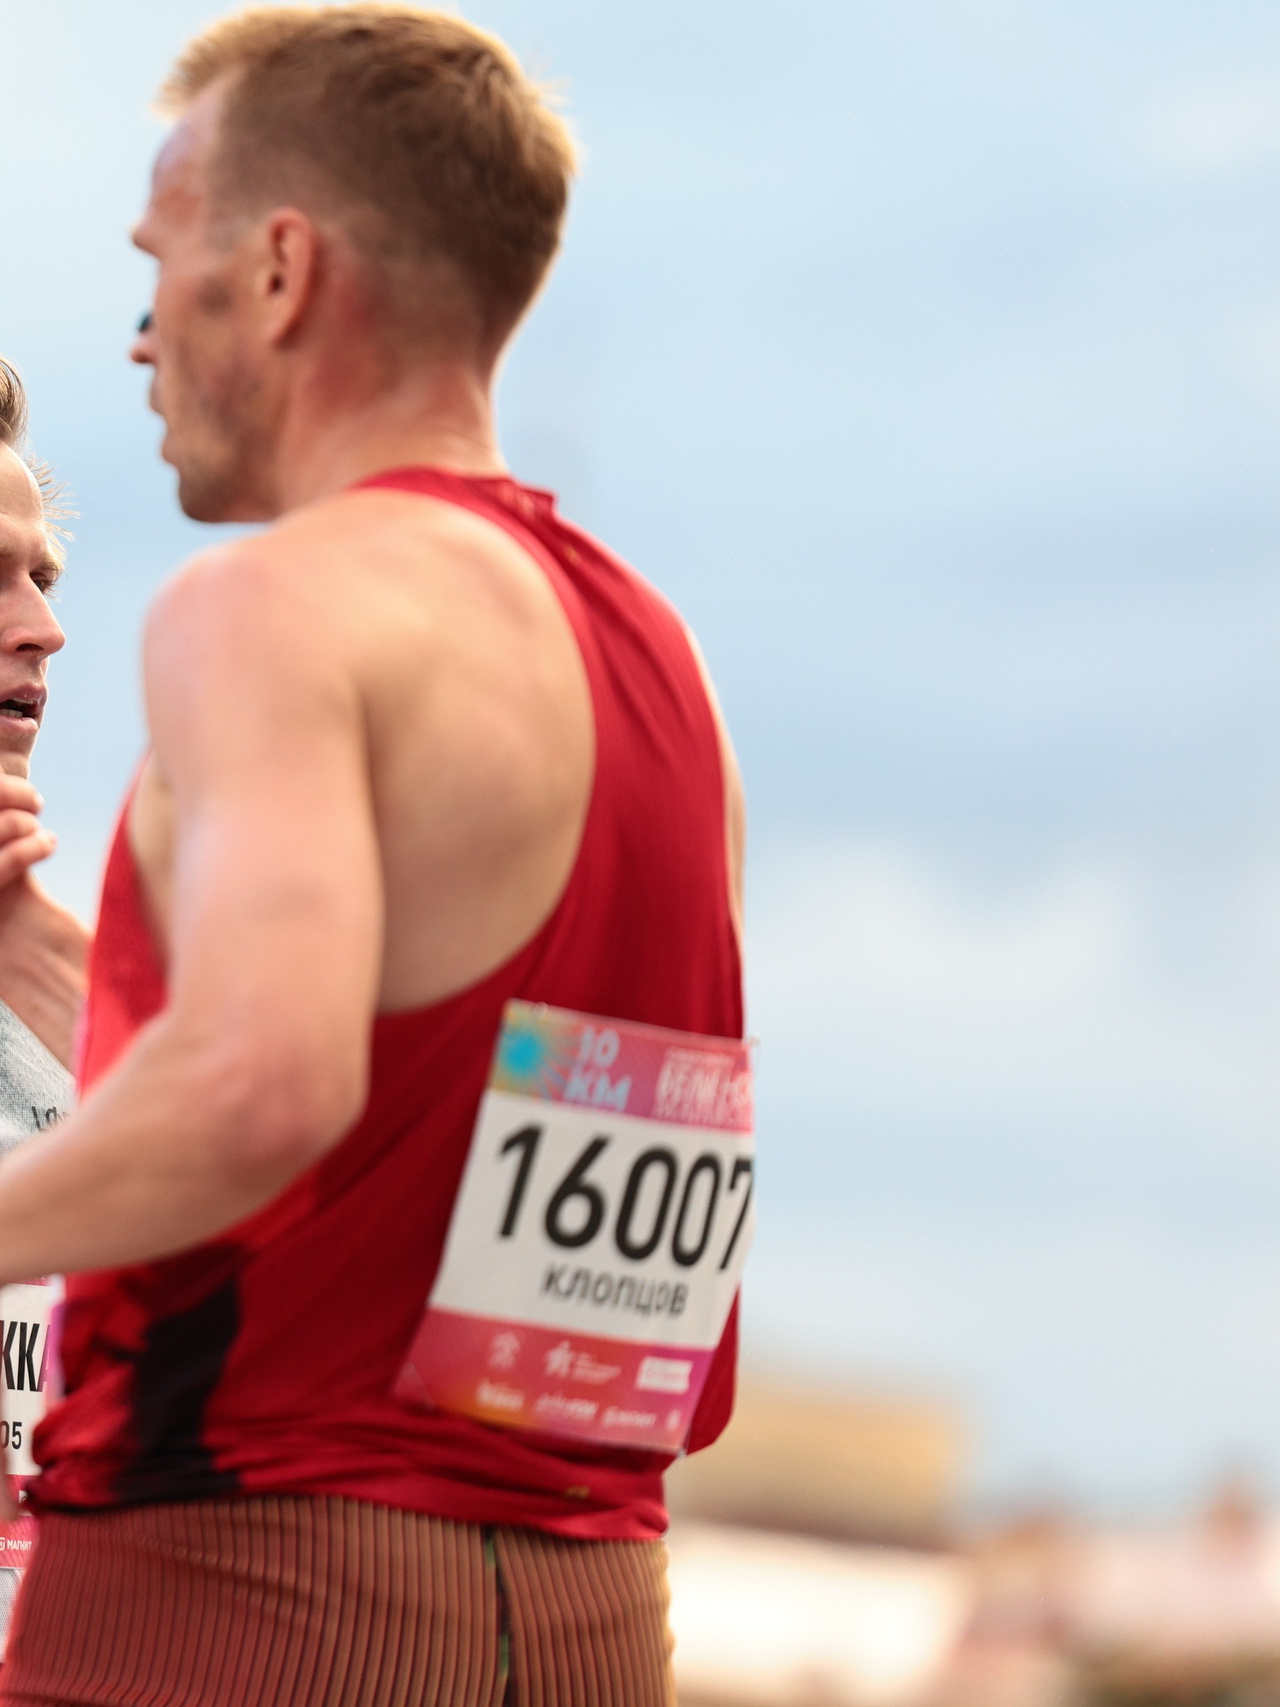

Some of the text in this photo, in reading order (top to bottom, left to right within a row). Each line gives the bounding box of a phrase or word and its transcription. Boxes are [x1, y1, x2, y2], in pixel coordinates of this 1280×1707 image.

[579, 1026, 620, 1066] 10
[498, 1124, 753, 1271] 16007
[7, 1540, 32, 1551] МАГНИТ
